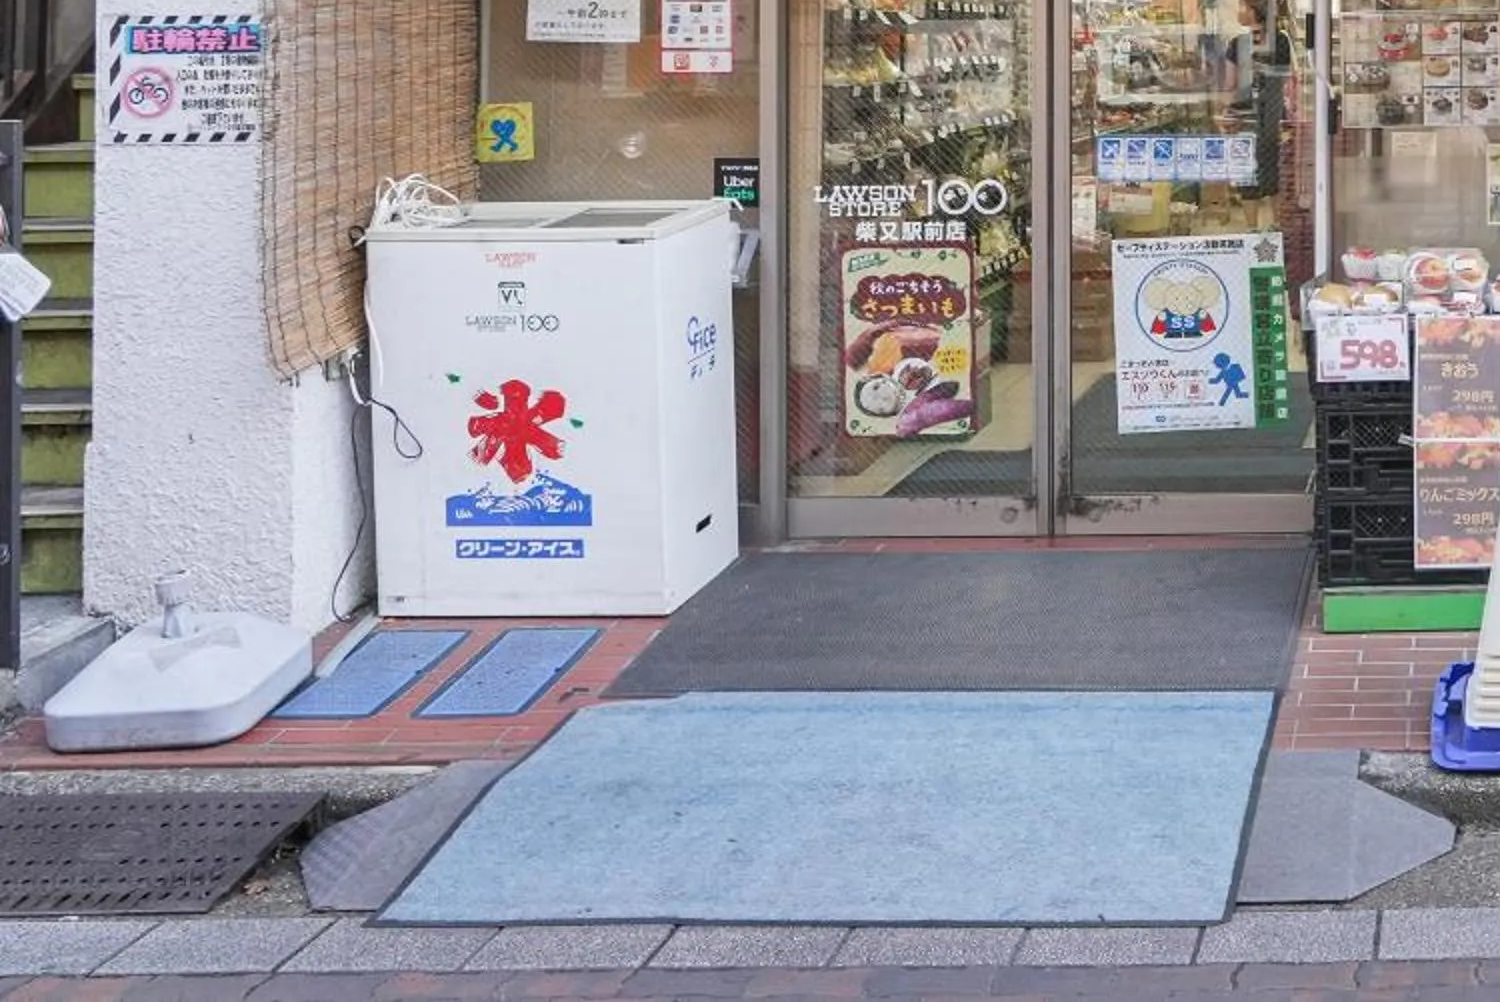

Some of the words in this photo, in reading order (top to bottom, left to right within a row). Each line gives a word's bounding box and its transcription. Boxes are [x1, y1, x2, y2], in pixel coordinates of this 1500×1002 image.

[131, 25, 262, 54] 駐輪禁止
[723, 175, 755, 187] Uber
[813, 185, 916, 203] LAWSON
[922, 179, 1007, 215] 100
[829, 201, 902, 217] STORE
[855, 222, 967, 242] 柴又駅前店
[861, 295, 956, 318] さつまいも
[1340, 339, 1399, 370] 598
[468, 380, 567, 484] 氷
[1419, 487, 1500, 503] りんごミックス
